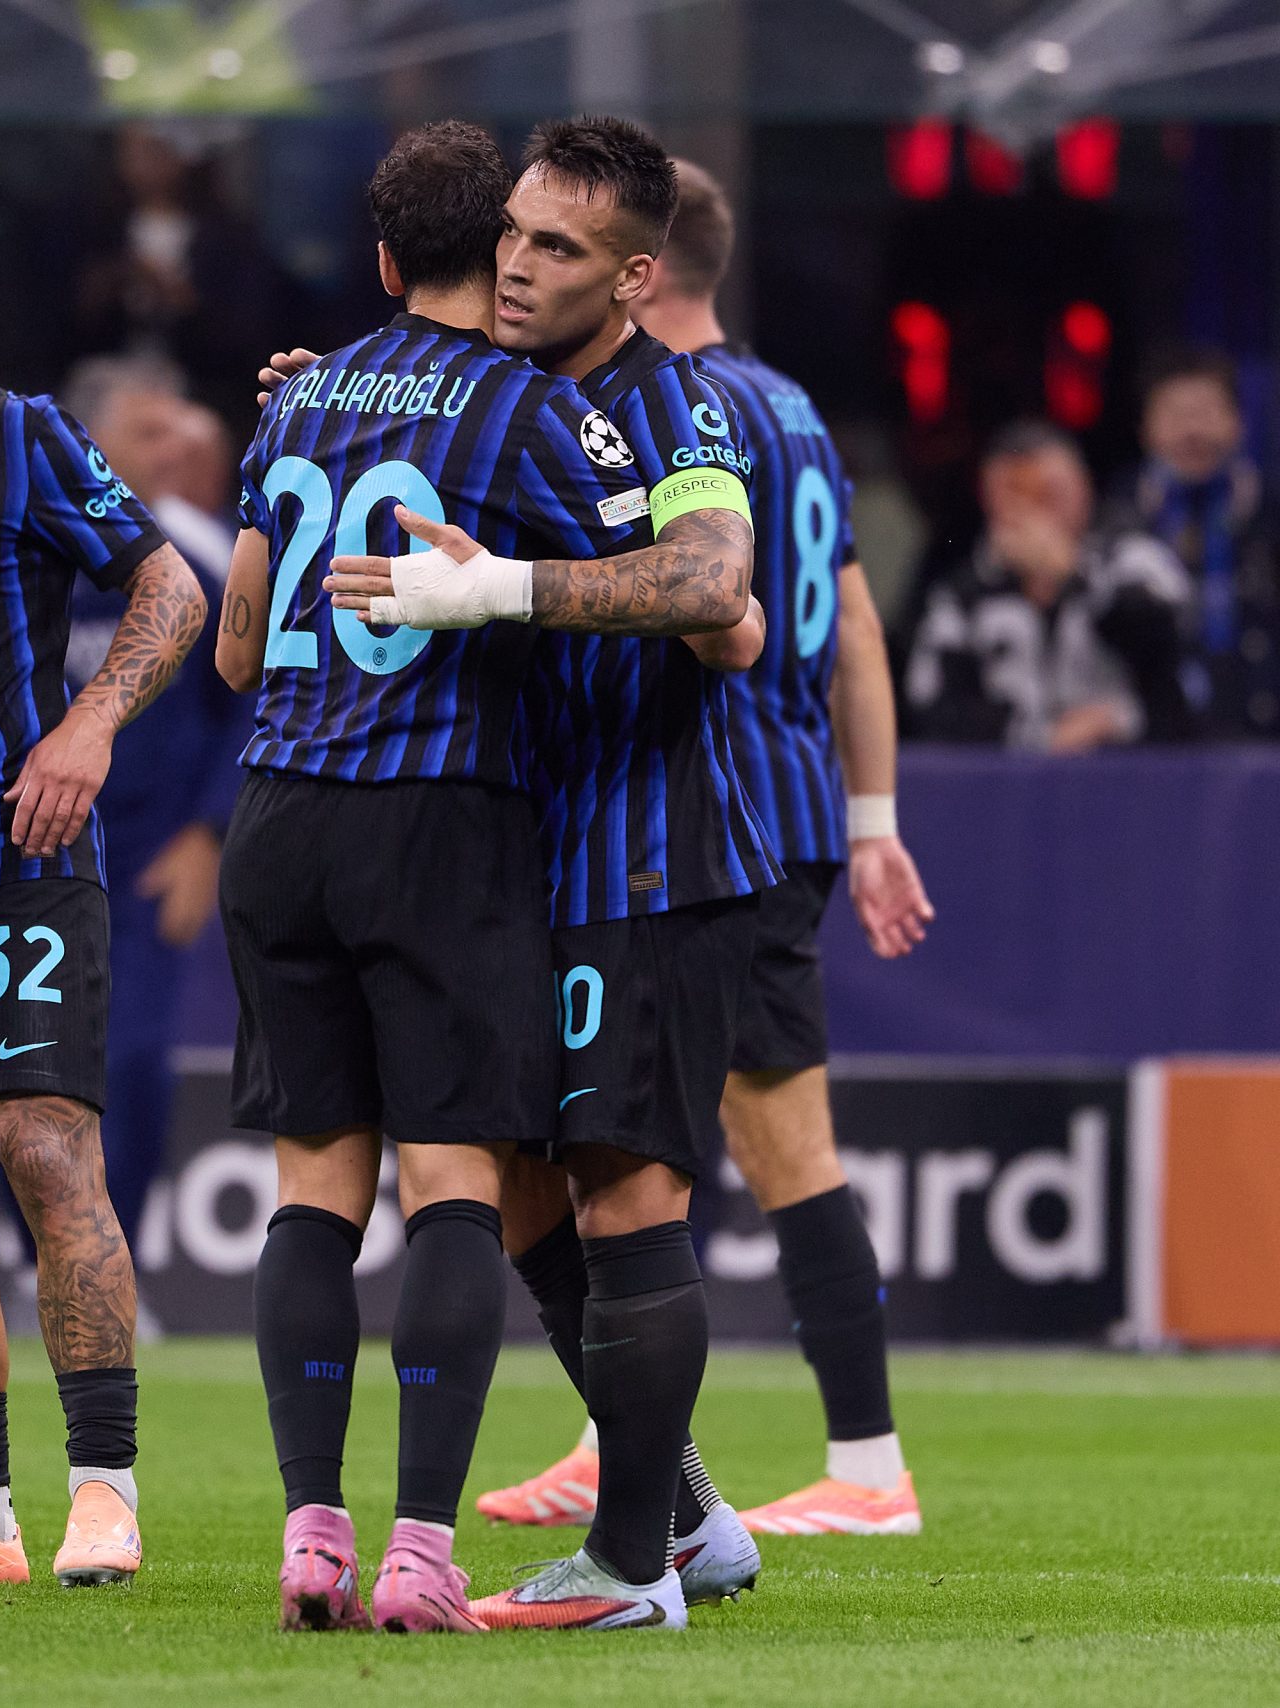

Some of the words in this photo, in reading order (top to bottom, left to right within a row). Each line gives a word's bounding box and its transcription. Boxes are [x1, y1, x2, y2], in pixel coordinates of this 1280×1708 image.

[671, 443, 752, 475] Gate.io
[602, 497, 649, 519] FOUNDATIO
[663, 479, 728, 502] RESPECT
[262, 455, 447, 675] 20
[793, 464, 839, 659] 8
[554, 965, 604, 1049] 0
